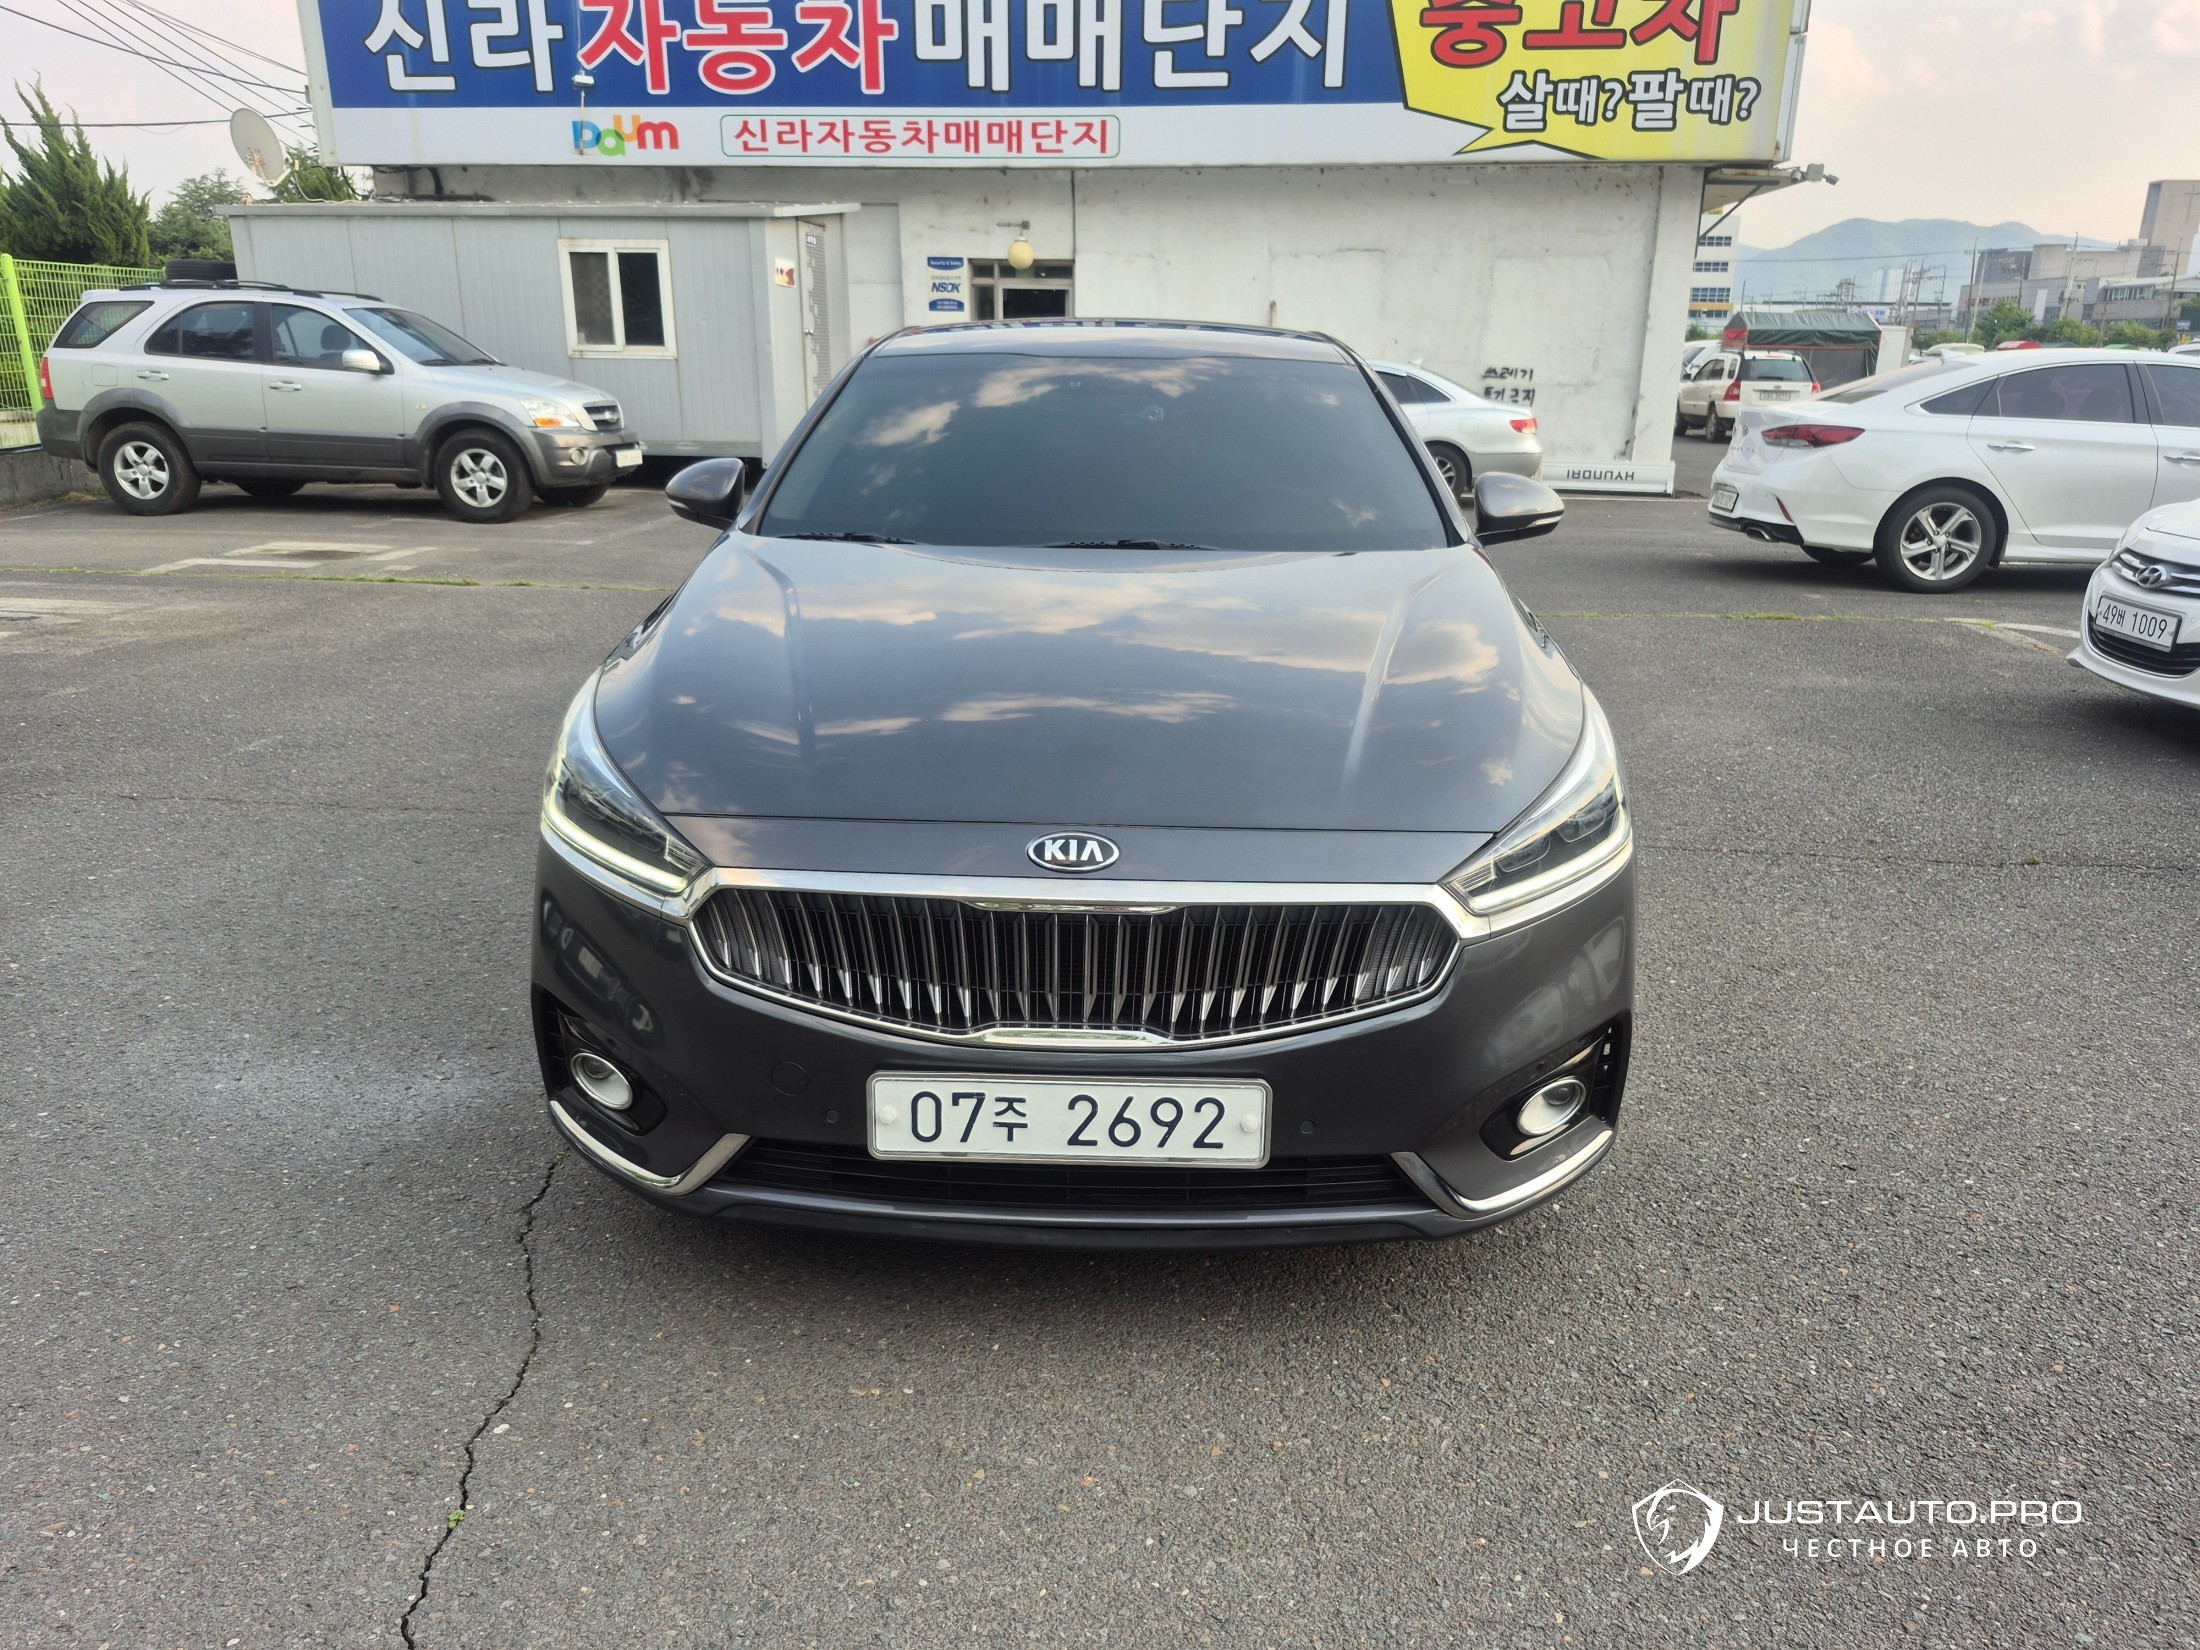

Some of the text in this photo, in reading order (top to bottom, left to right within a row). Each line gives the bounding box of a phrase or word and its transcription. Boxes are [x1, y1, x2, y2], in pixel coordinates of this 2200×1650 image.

[733, 118, 1109, 155] 신라자동차매매단지
[1566, 469, 1635, 481] HYUNDAI
[2131, 611, 2168, 640] 1009
[1044, 838, 1104, 862] KIA
[910, 1090, 1226, 1150] 07주 2692
